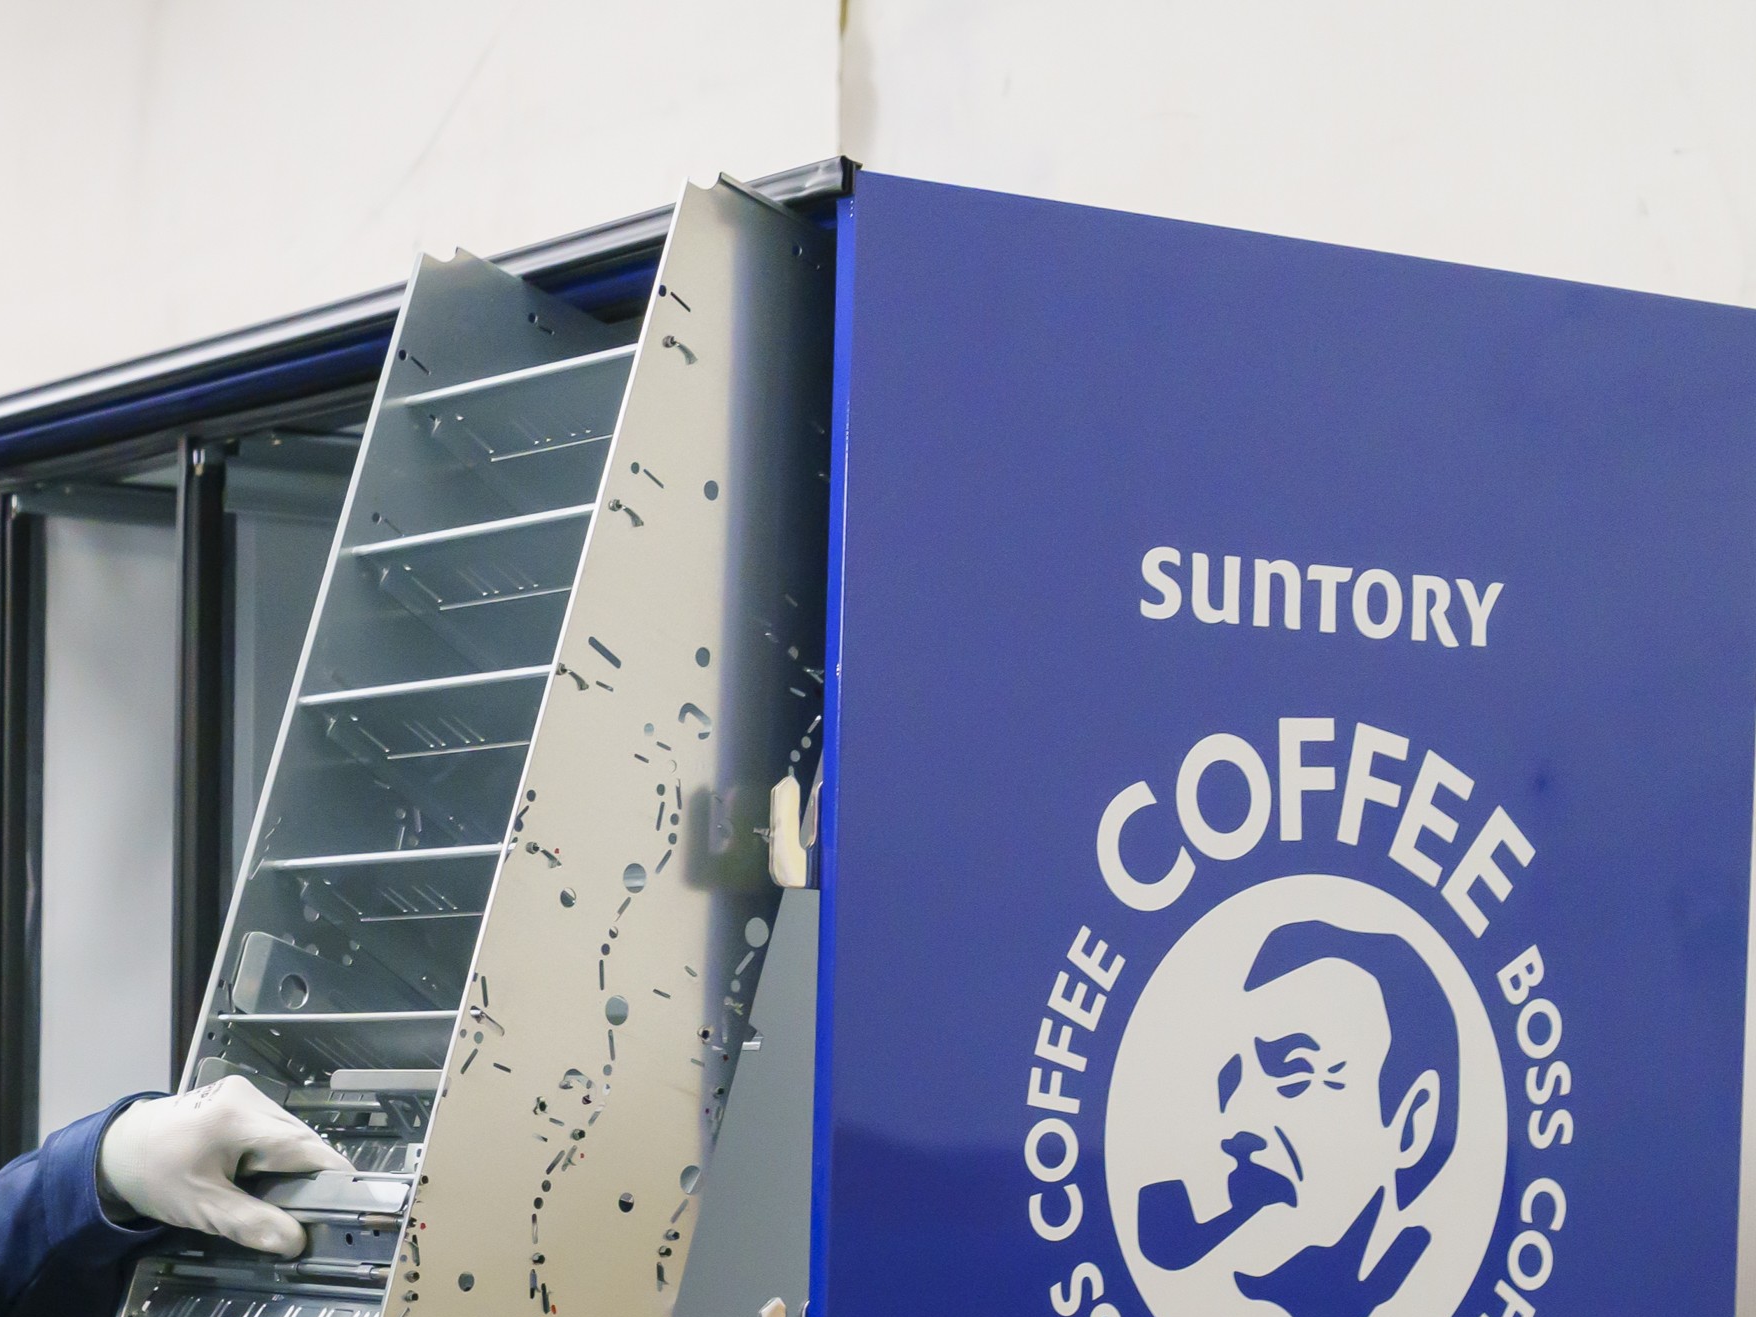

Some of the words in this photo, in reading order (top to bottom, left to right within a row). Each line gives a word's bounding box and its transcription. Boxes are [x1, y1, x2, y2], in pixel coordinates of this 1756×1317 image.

[1096, 717, 1536, 939] COFFEE
[1024, 924, 1126, 1242] COFFEE
[1496, 944, 1574, 1150] BOSS
